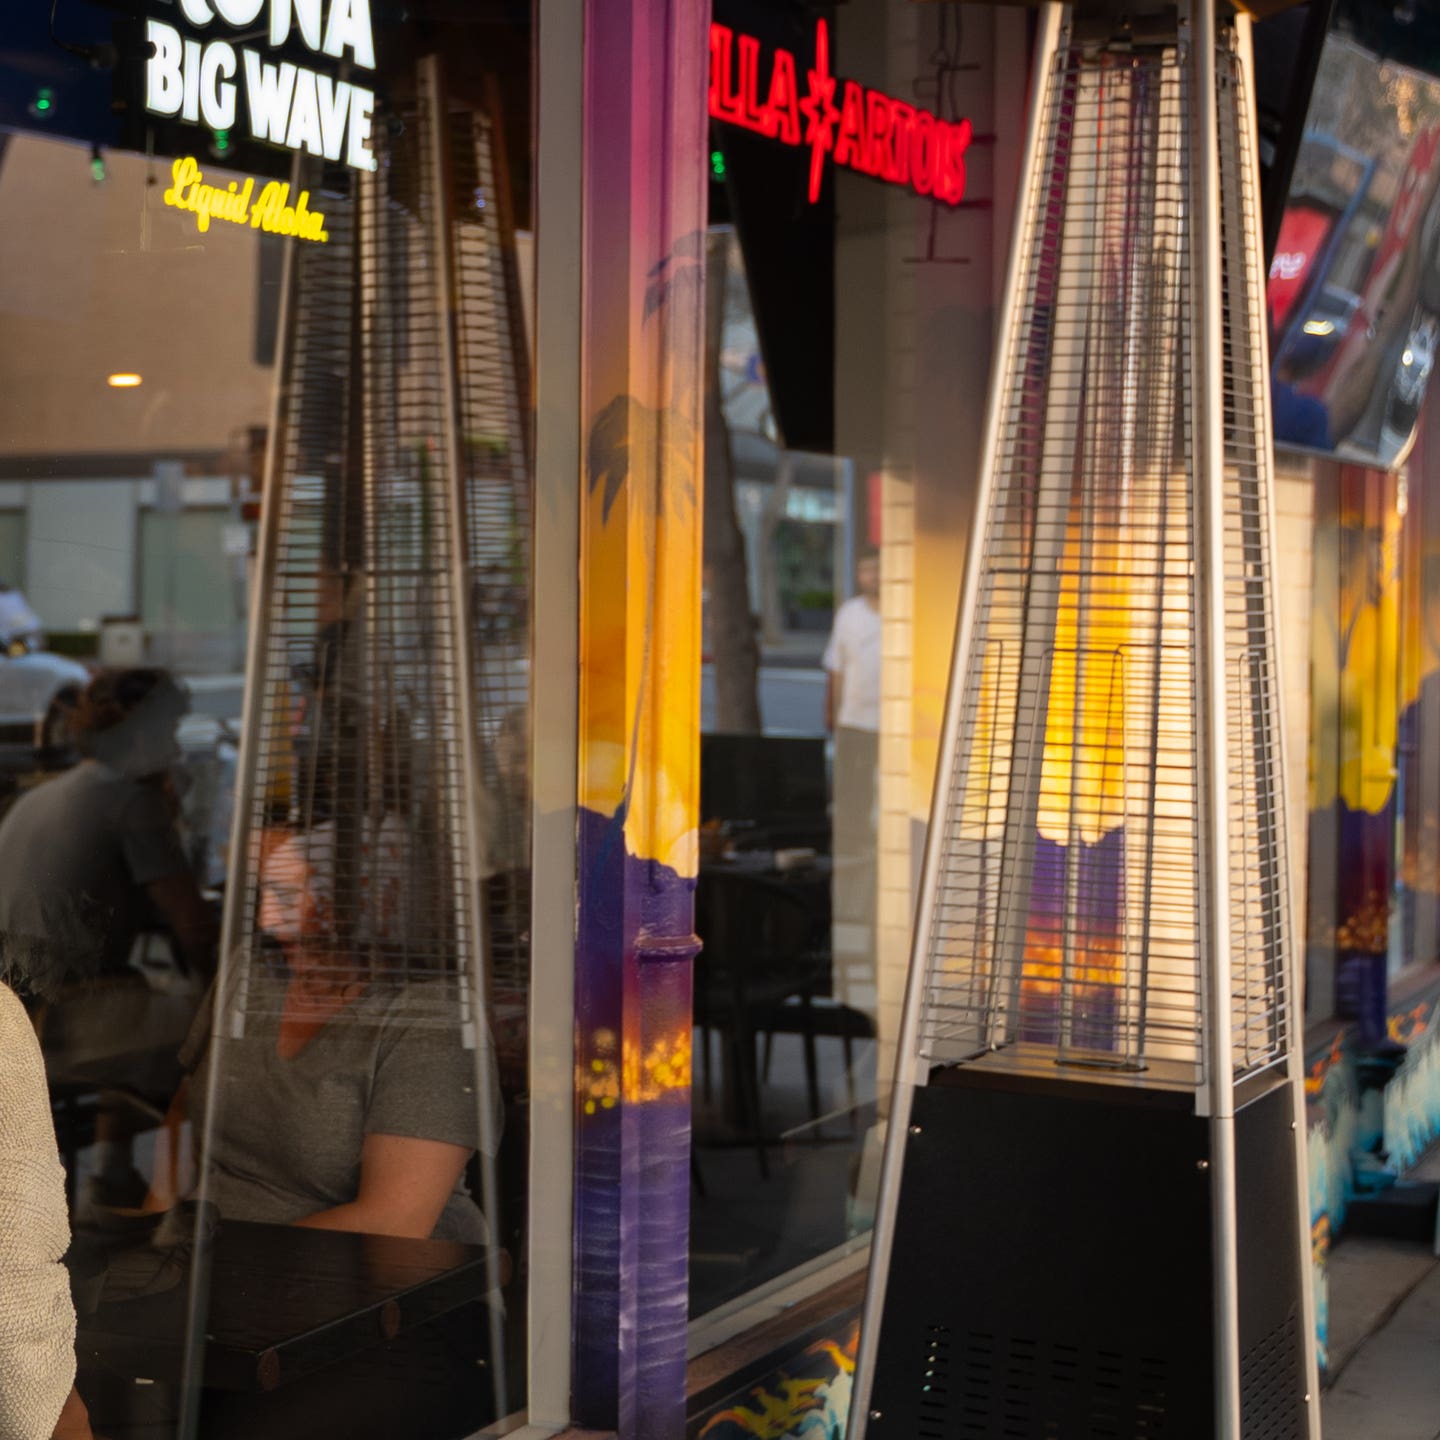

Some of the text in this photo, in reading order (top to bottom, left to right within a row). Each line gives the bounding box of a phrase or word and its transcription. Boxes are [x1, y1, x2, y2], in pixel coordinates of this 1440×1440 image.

[146, 18, 377, 173] BIG WAVE
[707, 21, 973, 206] LLA ARTOIS
[163, 156, 255, 233] Liquid
